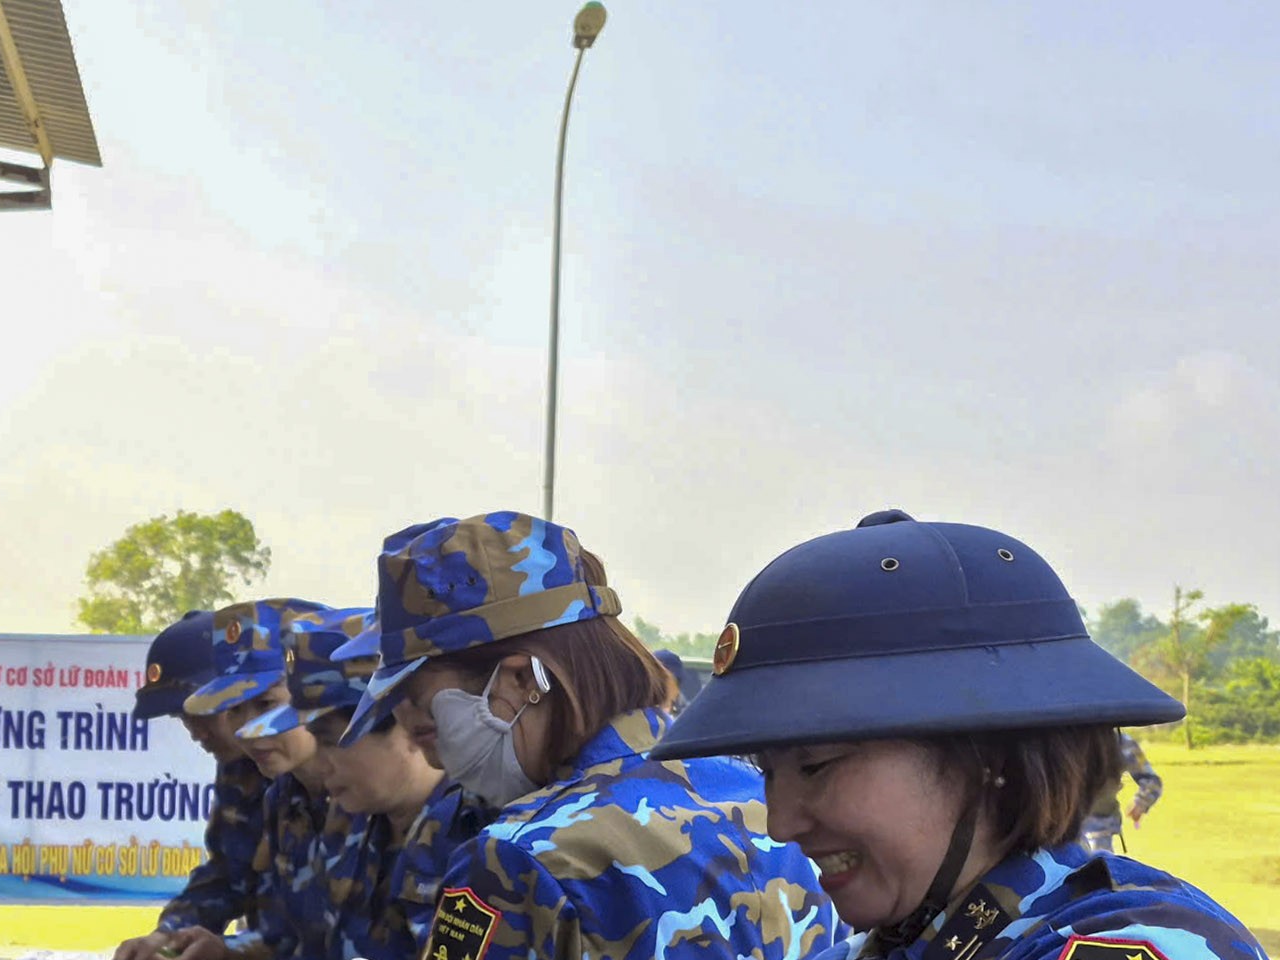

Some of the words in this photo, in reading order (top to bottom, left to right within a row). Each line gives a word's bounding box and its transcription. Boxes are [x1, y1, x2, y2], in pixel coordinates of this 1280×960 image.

[6, 666, 28, 687] CƠ
[32, 662, 55, 687] SỞ
[59, 664, 81, 687] LỮ
[83, 665, 128, 688] ĐOÀN
[56, 703, 149, 751] TRÌNH
[7, 780, 86, 820] THAO
[12, 837, 35, 881] HỘI
[40, 845, 69, 883] PHỤ
[72, 838, 94, 876] NỮ
[96, 842, 116, 876] CƠ
[120, 835, 139, 876] SỞ
[141, 839, 160, 877] LỮ
